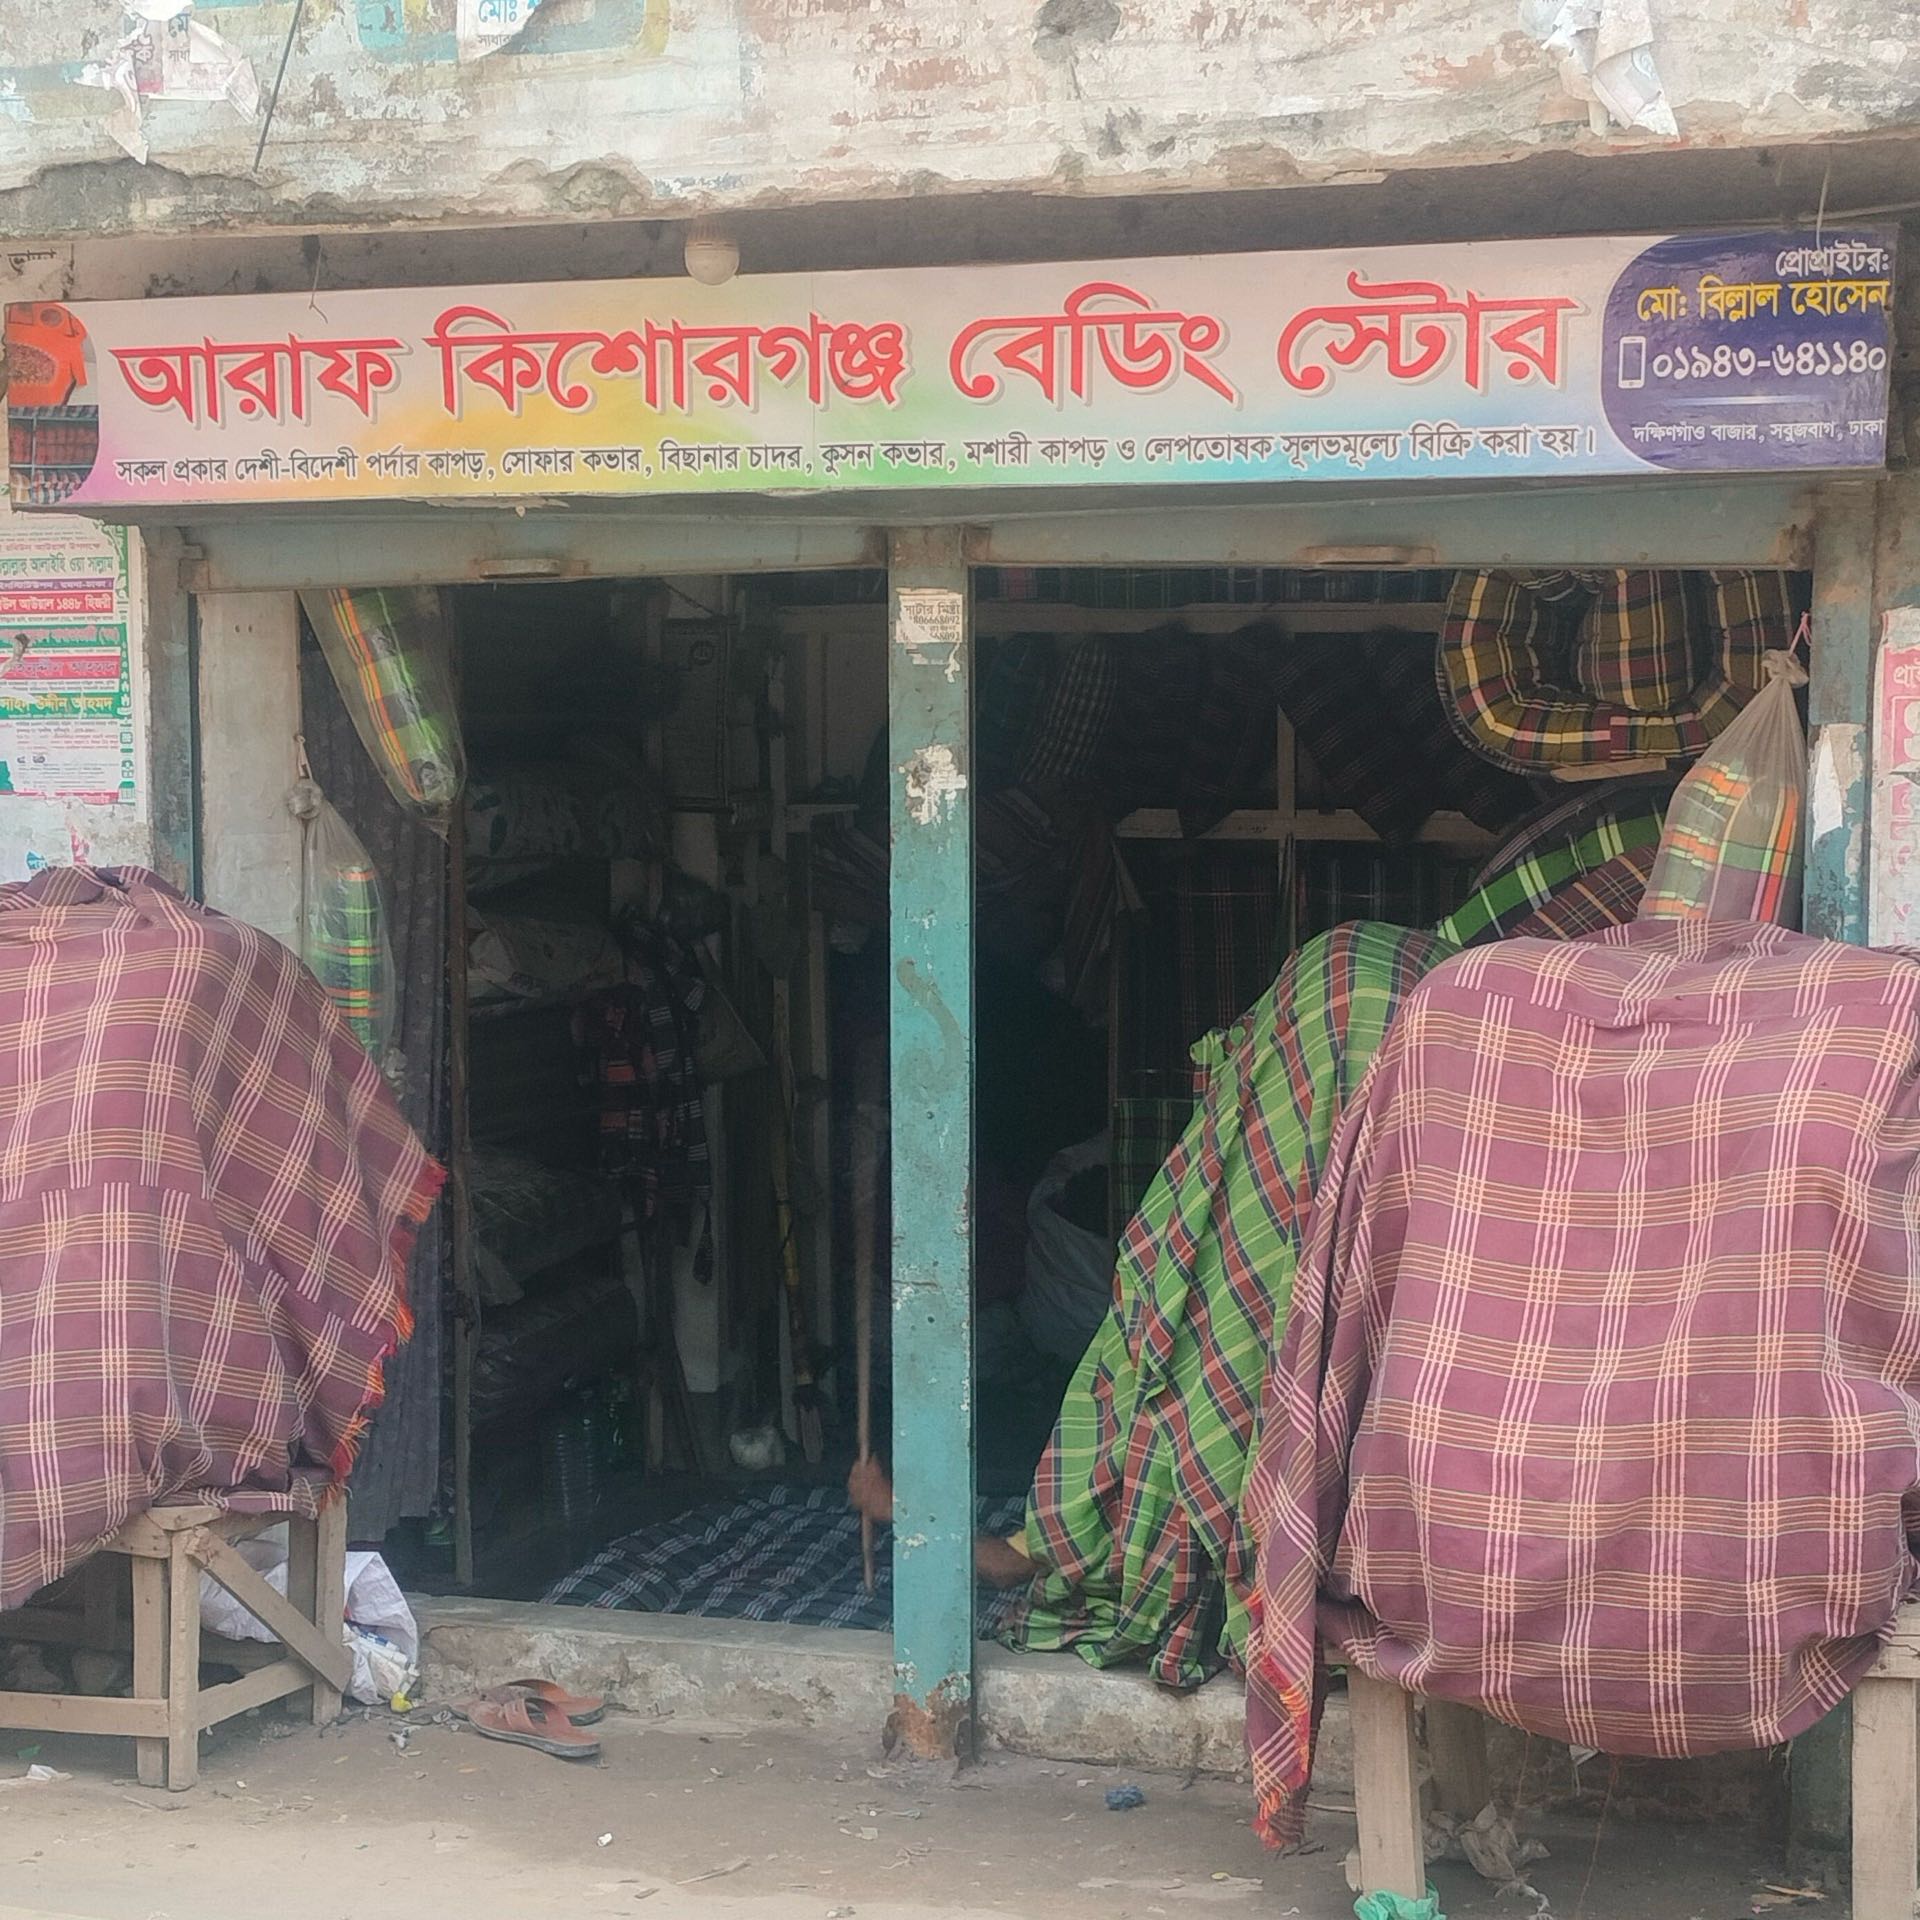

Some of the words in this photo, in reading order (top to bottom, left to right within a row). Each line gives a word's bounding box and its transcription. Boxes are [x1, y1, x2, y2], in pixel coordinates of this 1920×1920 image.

[1697, 273, 1783, 323] বিল্লাল
[1788, 279, 1891, 317] হোসেন
[108, 332, 404, 423] আরাফ
[422, 304, 907, 416] কিশোরগঞ্জ
[949, 281, 1234, 404] বেডিং
[1276, 270, 1578, 391] স্টোর
[1652, 340, 1887, 381] ০১৯৪৩-৬৪১১৪০
[116, 459, 167, 483] সকল
[173, 457, 228, 481] প্রকার
[235, 448, 359, 480] দেশী-বিদেশী
[365, 445, 420, 477] পর্দার
[502, 446, 574, 473] সোফার
[659, 440, 740, 472] বিছানার
[820, 442, 874, 475] কুসন
[963, 431, 1032, 466] মশারী
[1038, 437, 1109, 468] কাপড়
[1116, 439, 1136, 462] ও
[1145, 433, 1274, 463] লেপতোষক
[1409, 423, 1473, 459] বিক্রি
[1479, 426, 1531, 457] করা
[1631, 420, 1705, 444] দক্ষিণগাঁও
[1848, 418, 1886, 437] ঢাকা
